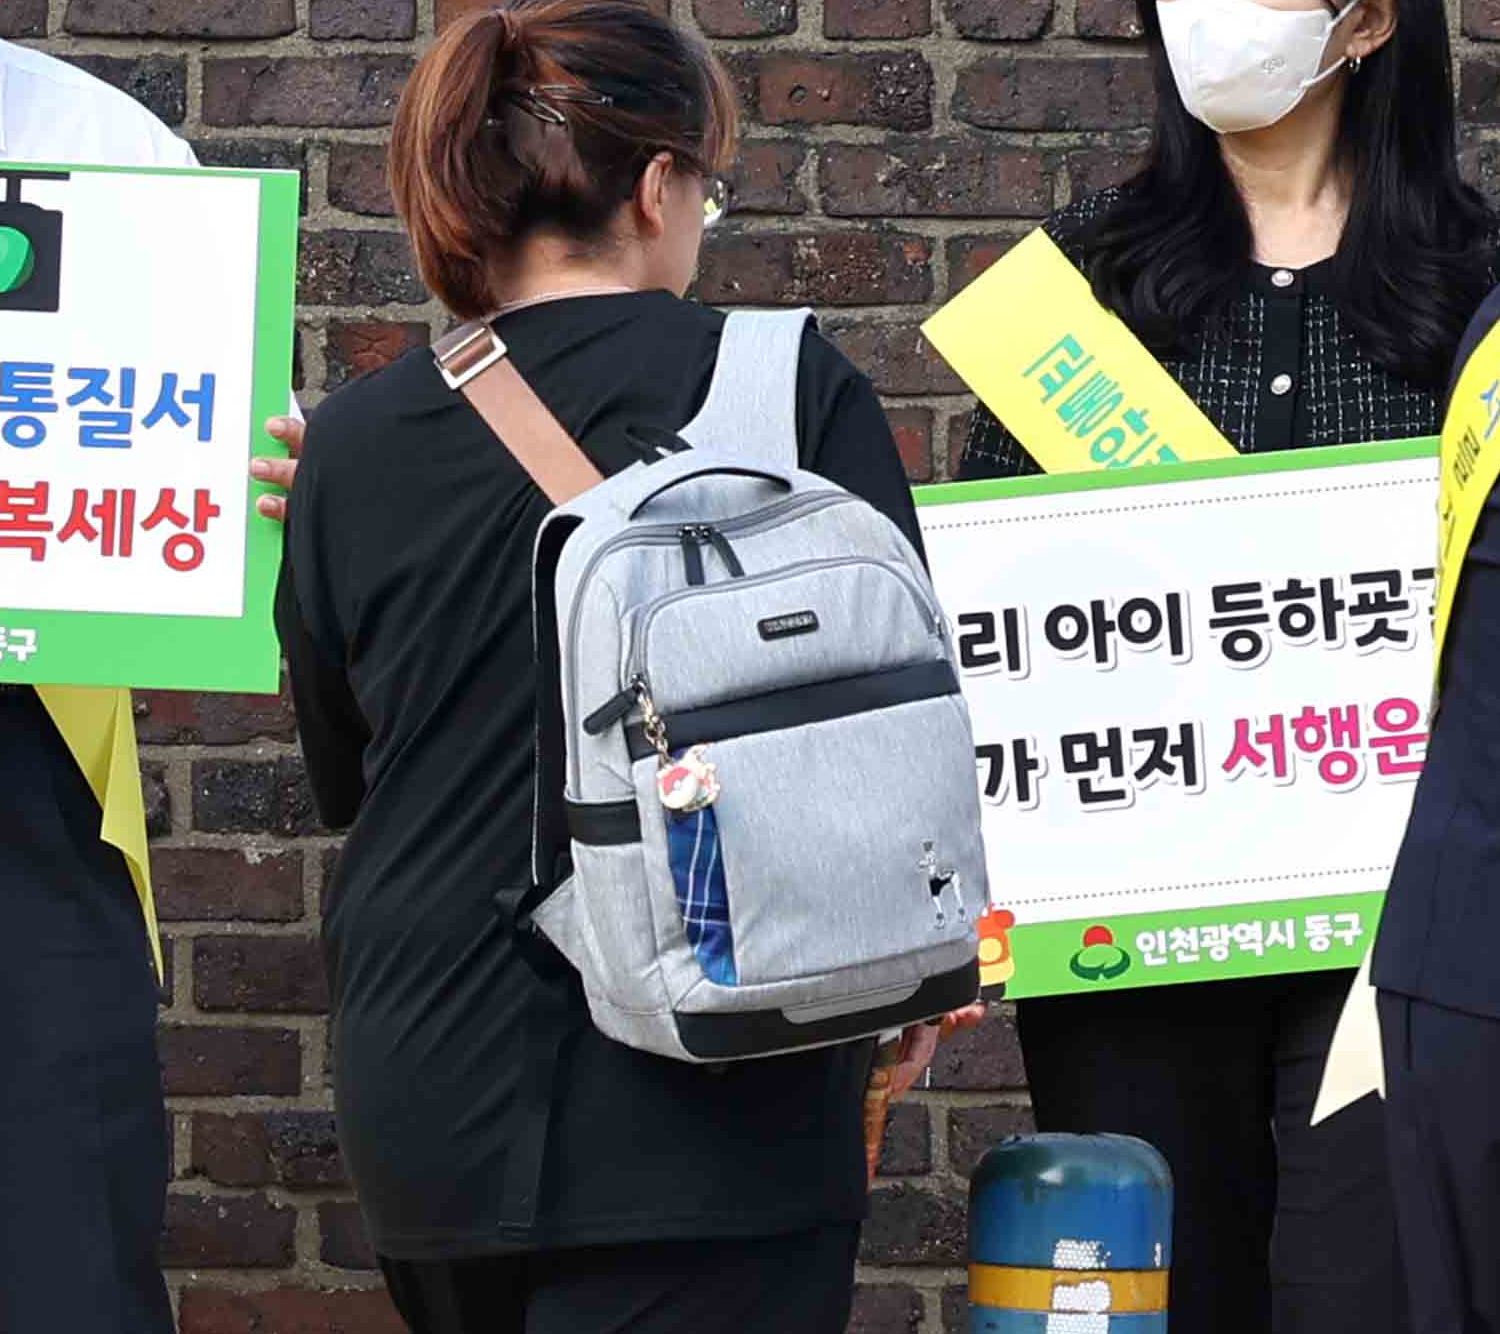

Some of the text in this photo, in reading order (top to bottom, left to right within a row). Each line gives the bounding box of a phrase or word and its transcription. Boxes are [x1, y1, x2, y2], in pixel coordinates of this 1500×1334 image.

[1022, 332, 1182, 468] 교통안
[957, 607, 1022, 672] 리
[1043, 592, 1186, 666] 아이
[974, 697, 1432, 803] 가 먼저 서행운
[1135, 912, 1364, 966] 인천광역시 동구
